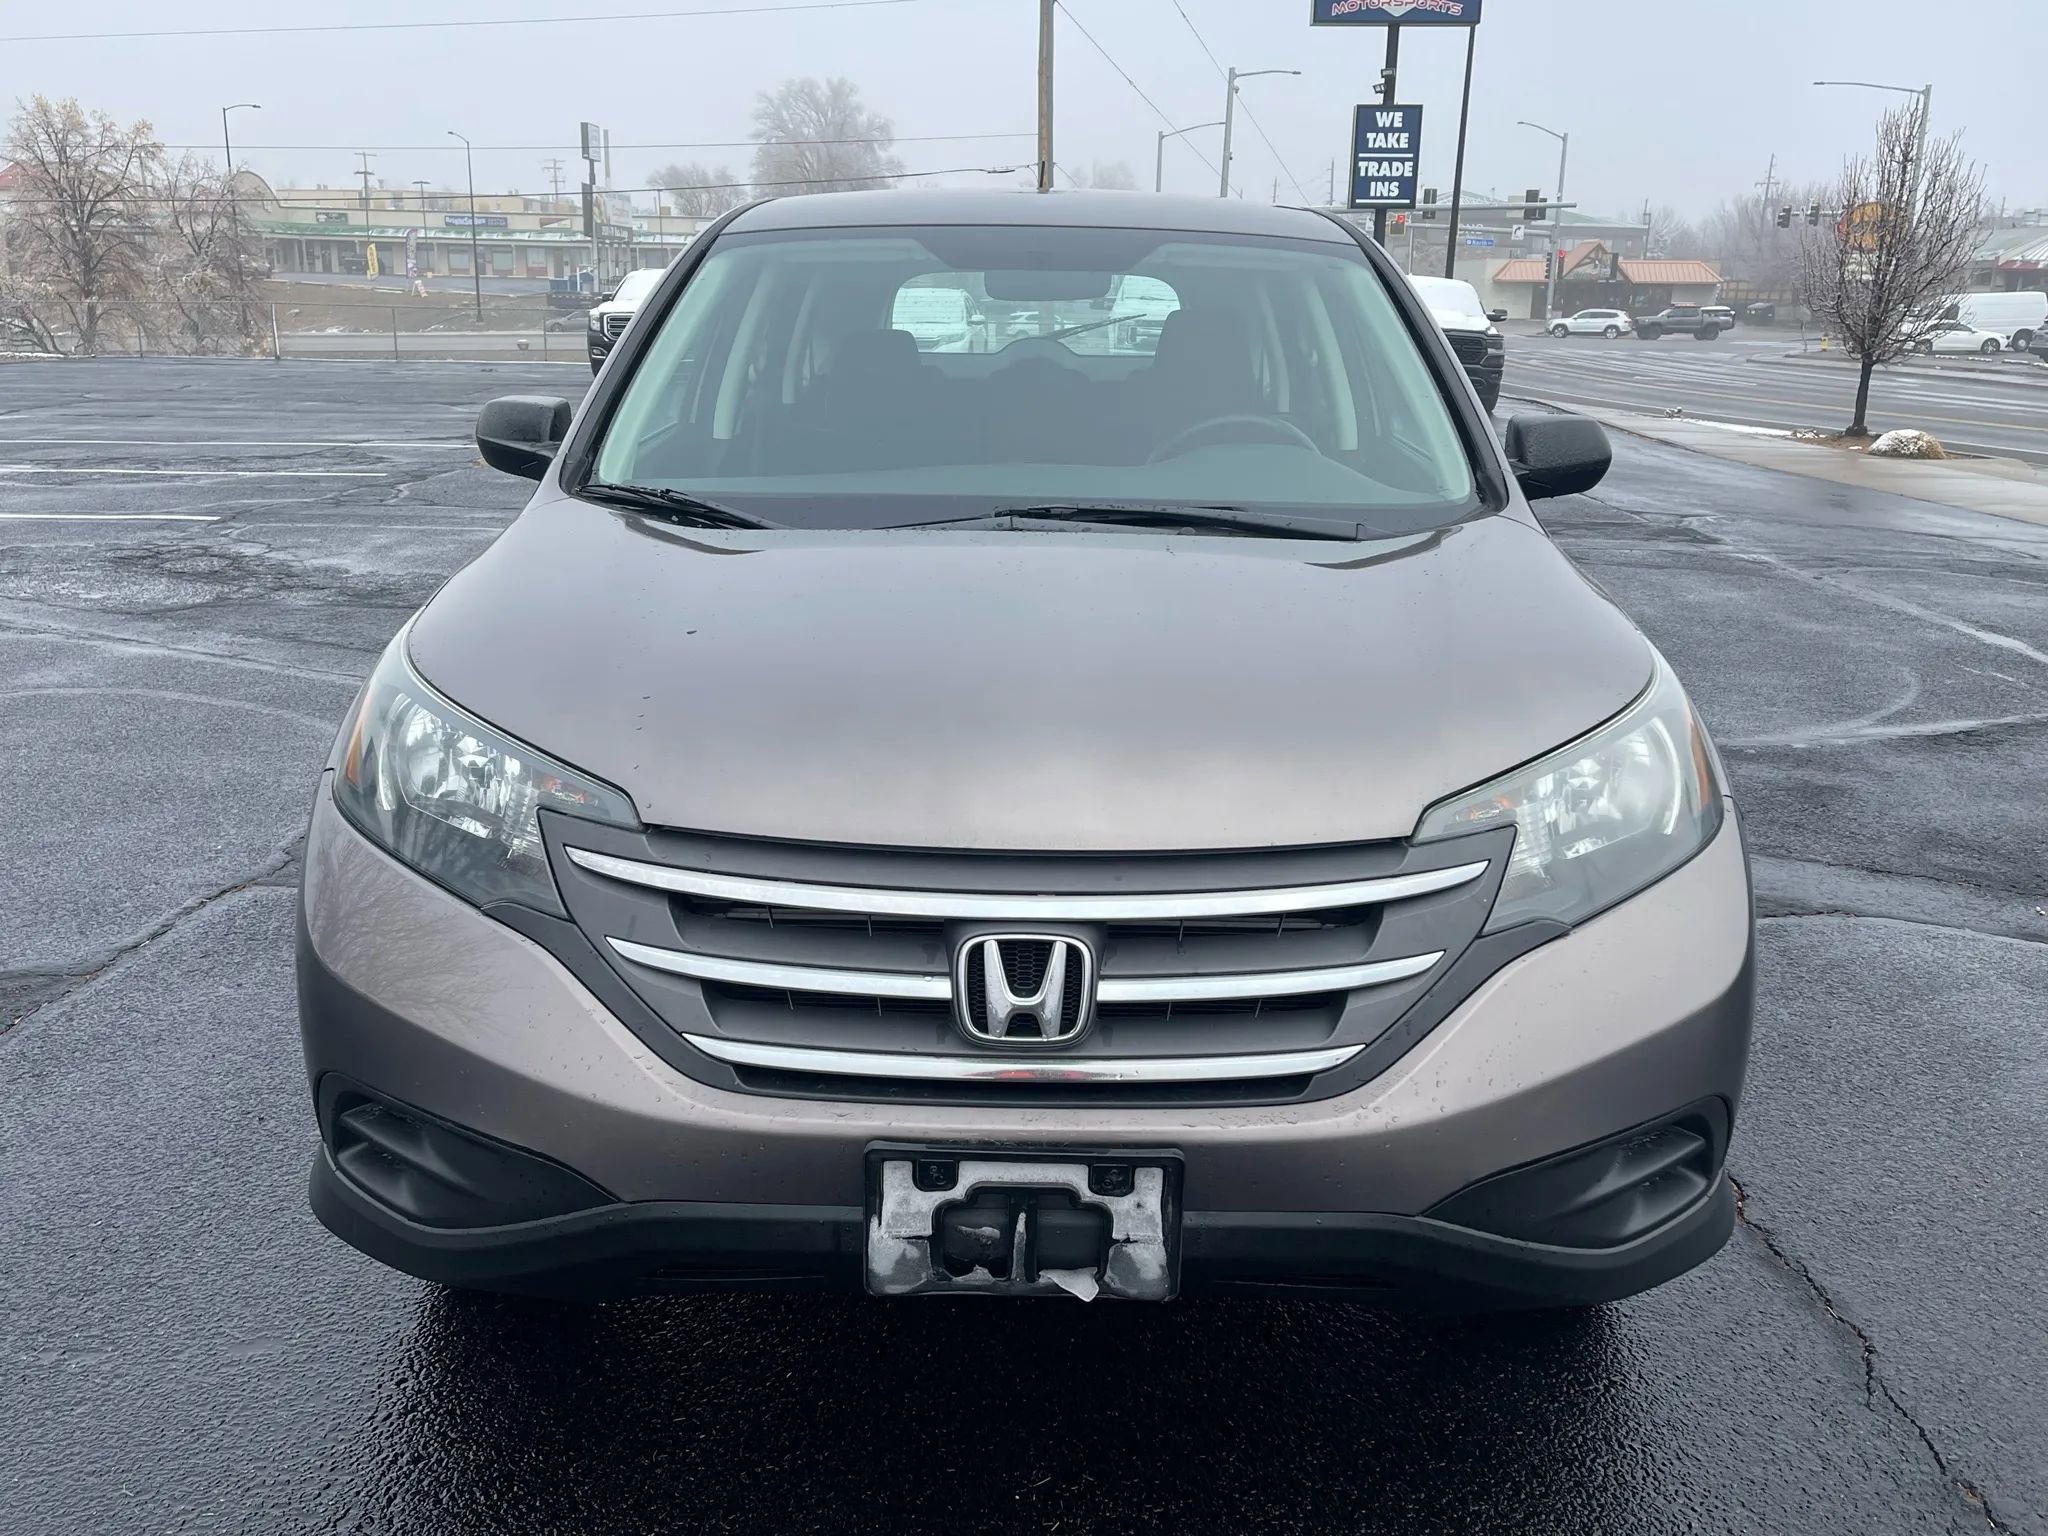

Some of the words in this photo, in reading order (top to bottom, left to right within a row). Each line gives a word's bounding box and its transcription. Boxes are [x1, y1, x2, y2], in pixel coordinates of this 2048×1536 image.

[1331, 0, 1464, 16] MOTORSPORTS
[1375, 111, 1403, 128] WE
[1366, 132, 1409, 149] TAKE
[1358, 161, 1413, 177] TRADE
[1370, 181, 1400, 197] INS
